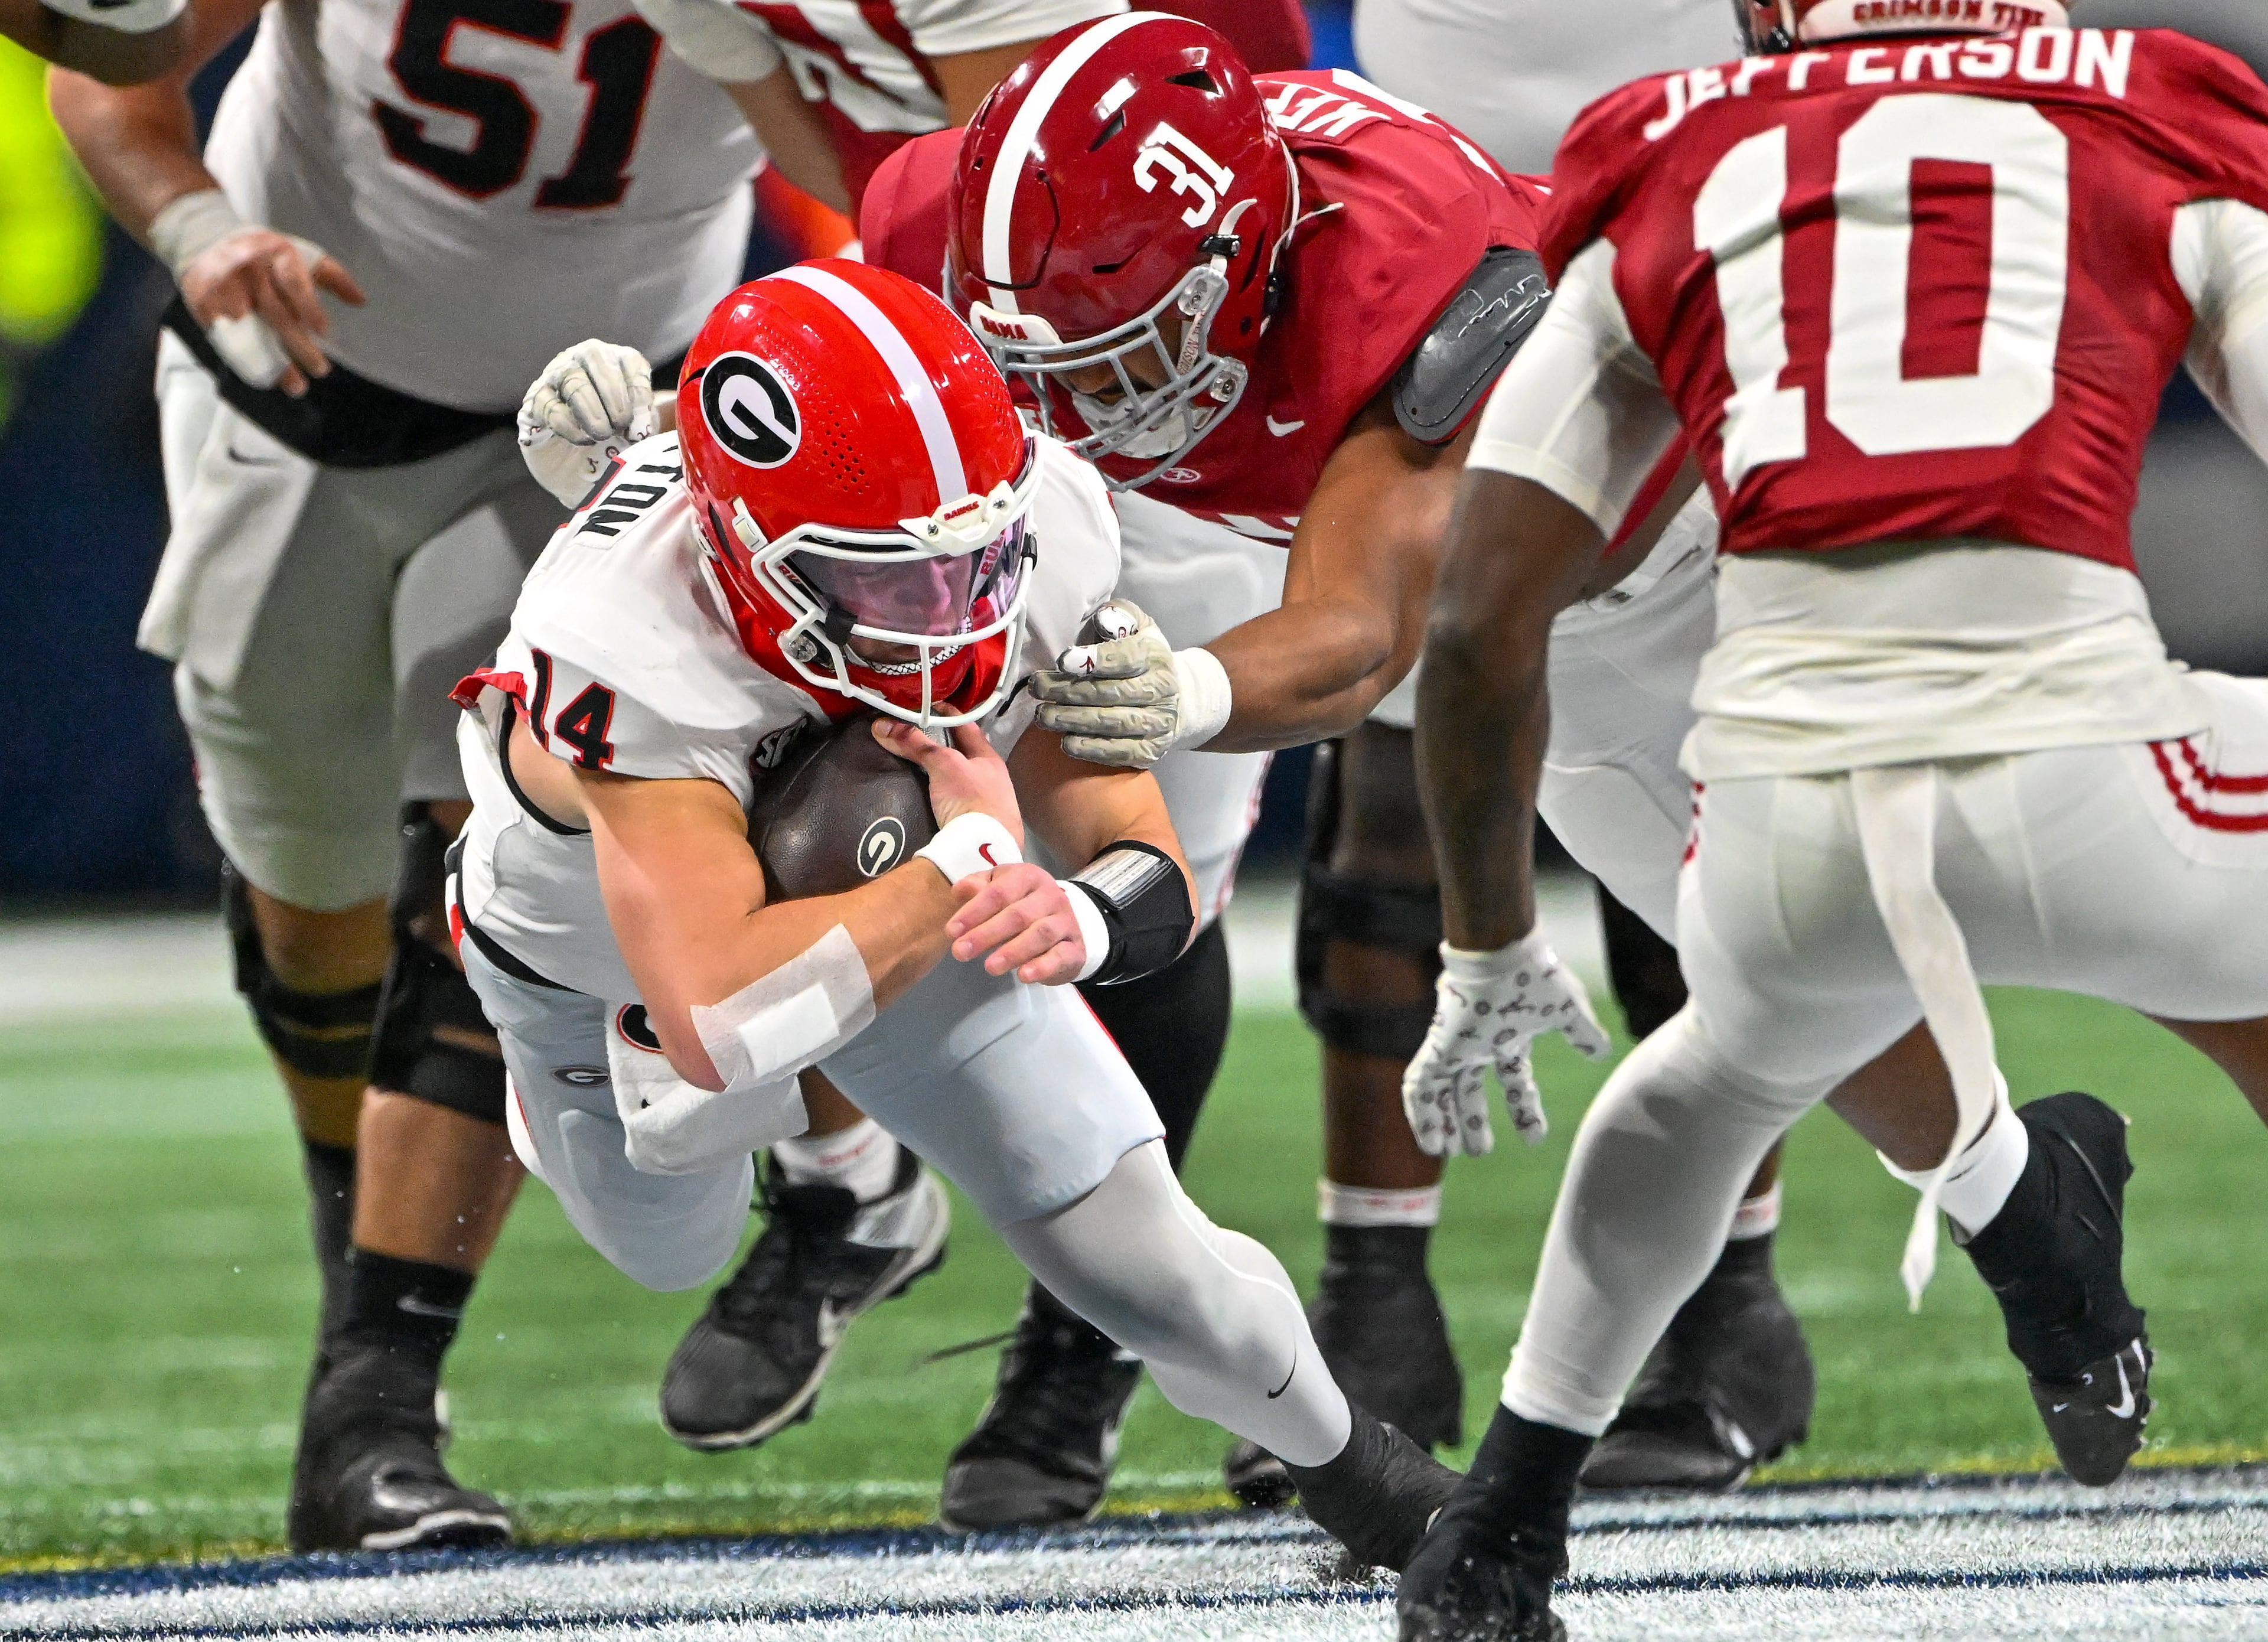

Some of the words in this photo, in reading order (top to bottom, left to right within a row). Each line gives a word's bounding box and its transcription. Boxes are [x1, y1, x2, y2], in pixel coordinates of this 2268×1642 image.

[370, 0, 664, 209] 51
[1644, 28, 2135, 141] JEFFERSON
[1133, 120, 1235, 229] 31
[1693, 93, 2070, 495] 10
[699, 350, 802, 470] G
[530, 647, 616, 771] 14
[857, 816, 906, 877] G
